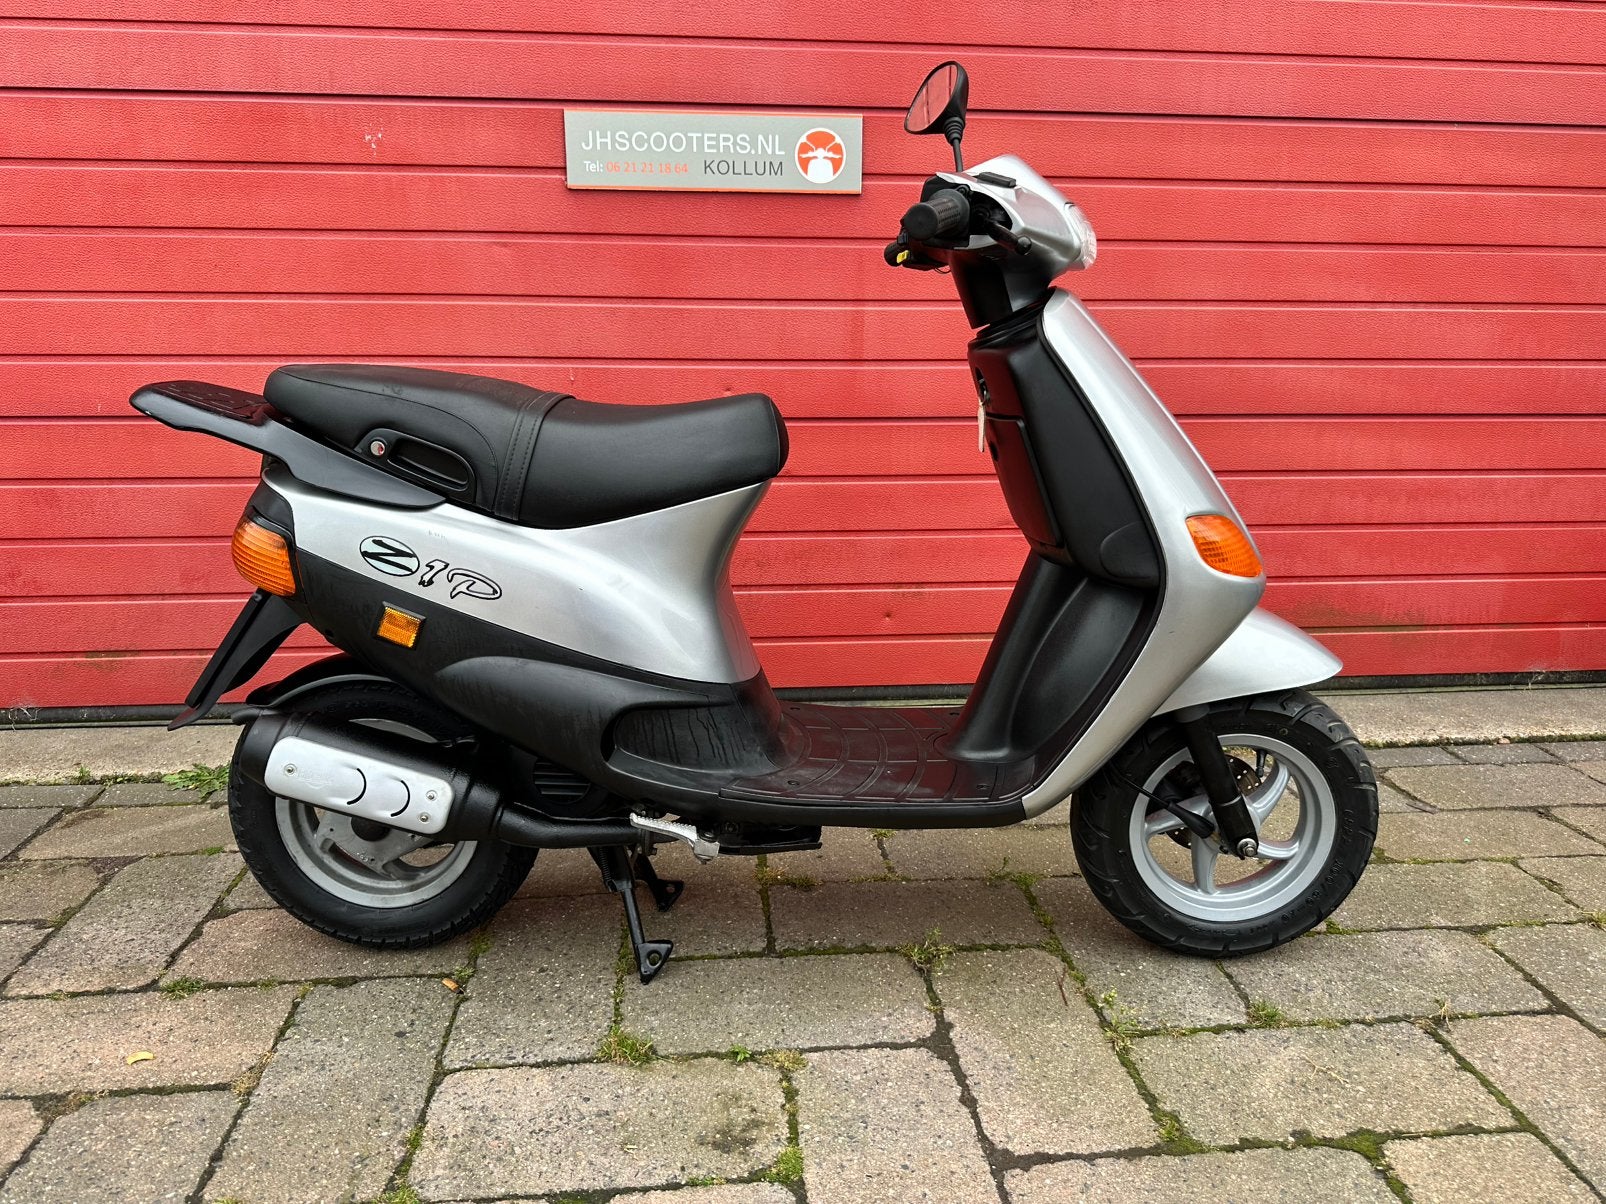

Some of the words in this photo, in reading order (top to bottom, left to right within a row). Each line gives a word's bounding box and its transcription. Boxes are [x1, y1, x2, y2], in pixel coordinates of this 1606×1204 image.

[581, 131, 785, 155] JHSCOOTERS.NL
[584, 161, 603, 173] Tel:
[606, 161, 621, 173] 06
[624, 162, 637, 173] 21
[641, 162, 655, 174] 21
[660, 163, 672, 175] 18
[674, 163, 689, 175] 64
[704, 159, 783, 176] KOLLUM
